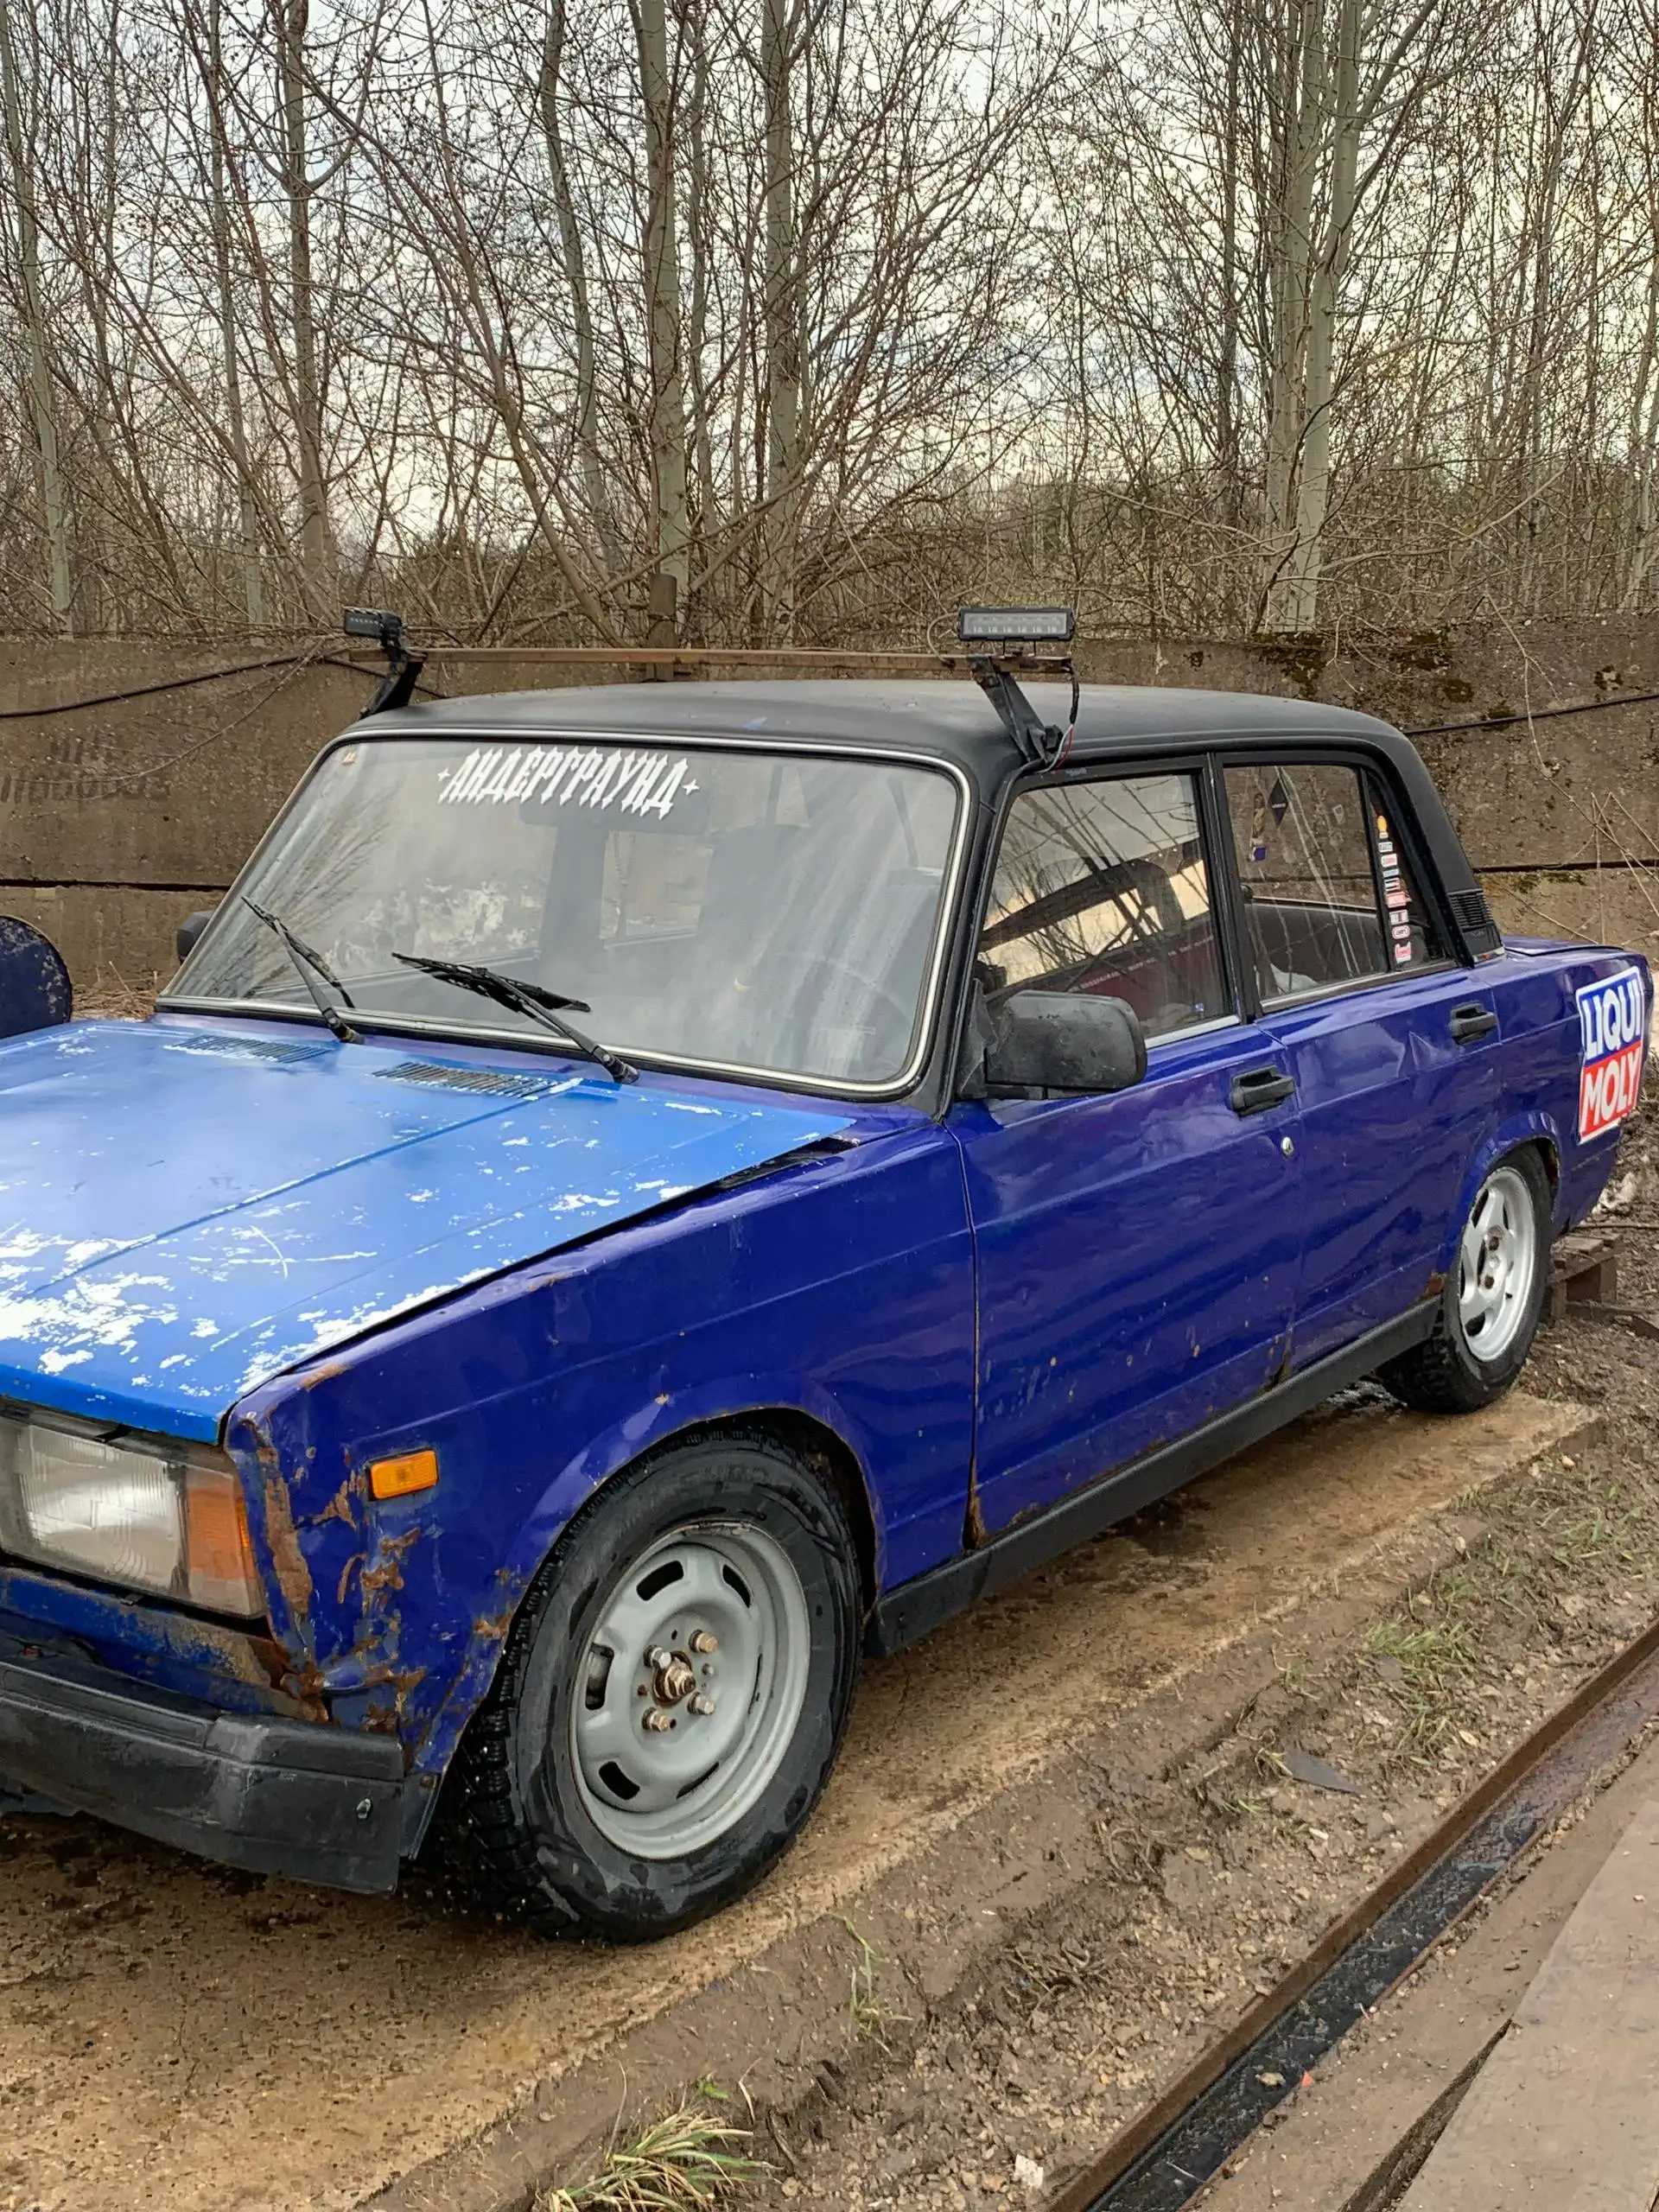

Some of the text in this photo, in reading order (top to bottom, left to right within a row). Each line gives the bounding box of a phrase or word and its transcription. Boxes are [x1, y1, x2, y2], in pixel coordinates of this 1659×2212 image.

[438, 745, 688, 820] АНДЕРГРАУНД
[1582, 979, 1641, 1060] LIQUI
[1580, 1048, 1641, 1132] MOLY
